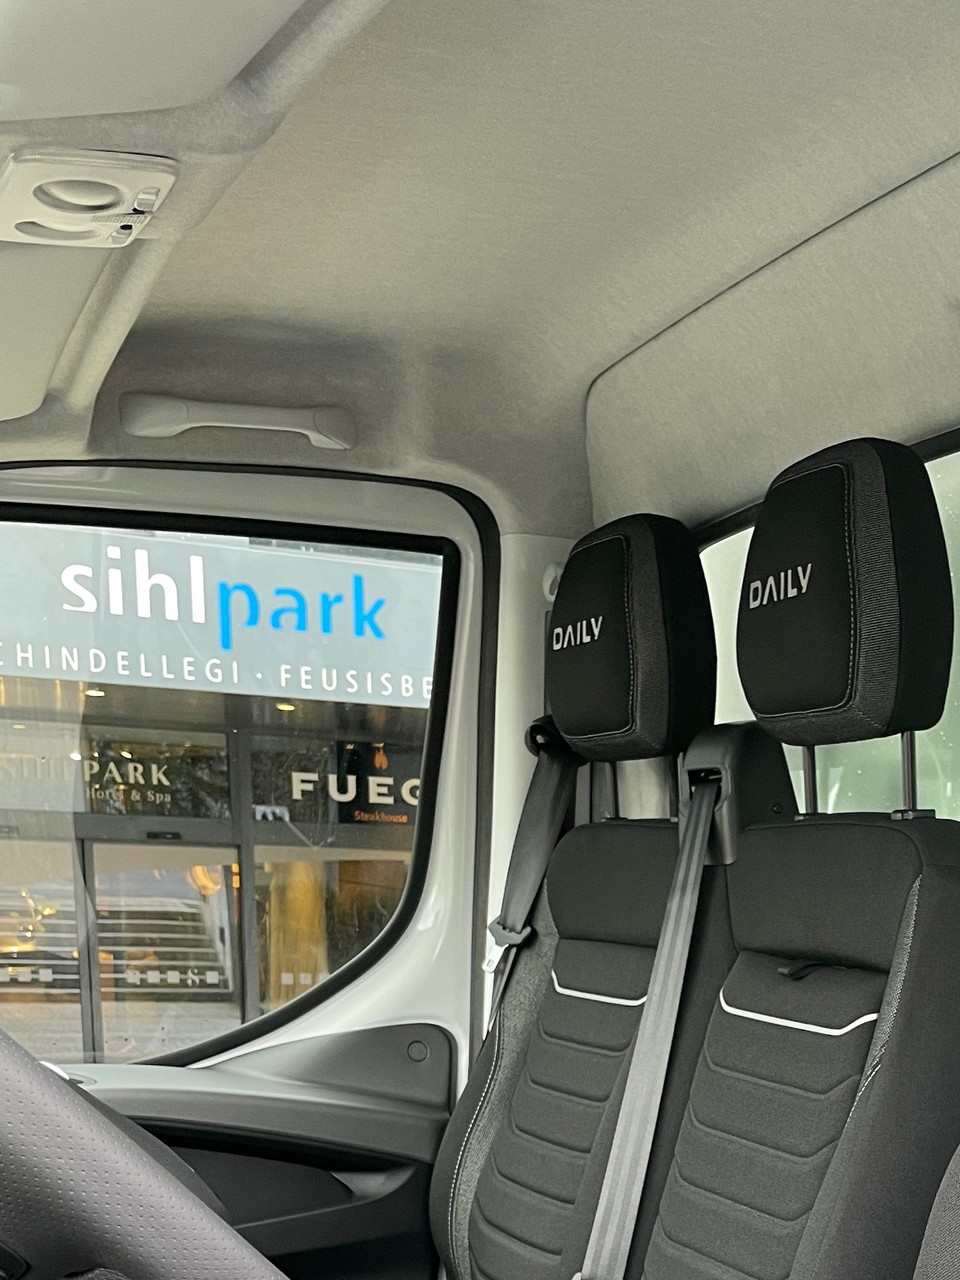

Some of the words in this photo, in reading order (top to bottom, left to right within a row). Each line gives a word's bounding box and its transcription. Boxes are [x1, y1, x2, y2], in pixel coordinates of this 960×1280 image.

[750, 563, 812, 609] DAILY
[552, 616, 603, 651] DAILY
[0, 641, 239, 685] HINDELLEGI
[147, 789, 172, 804] Spa
[354, 810, 408, 823] Steakhouse
